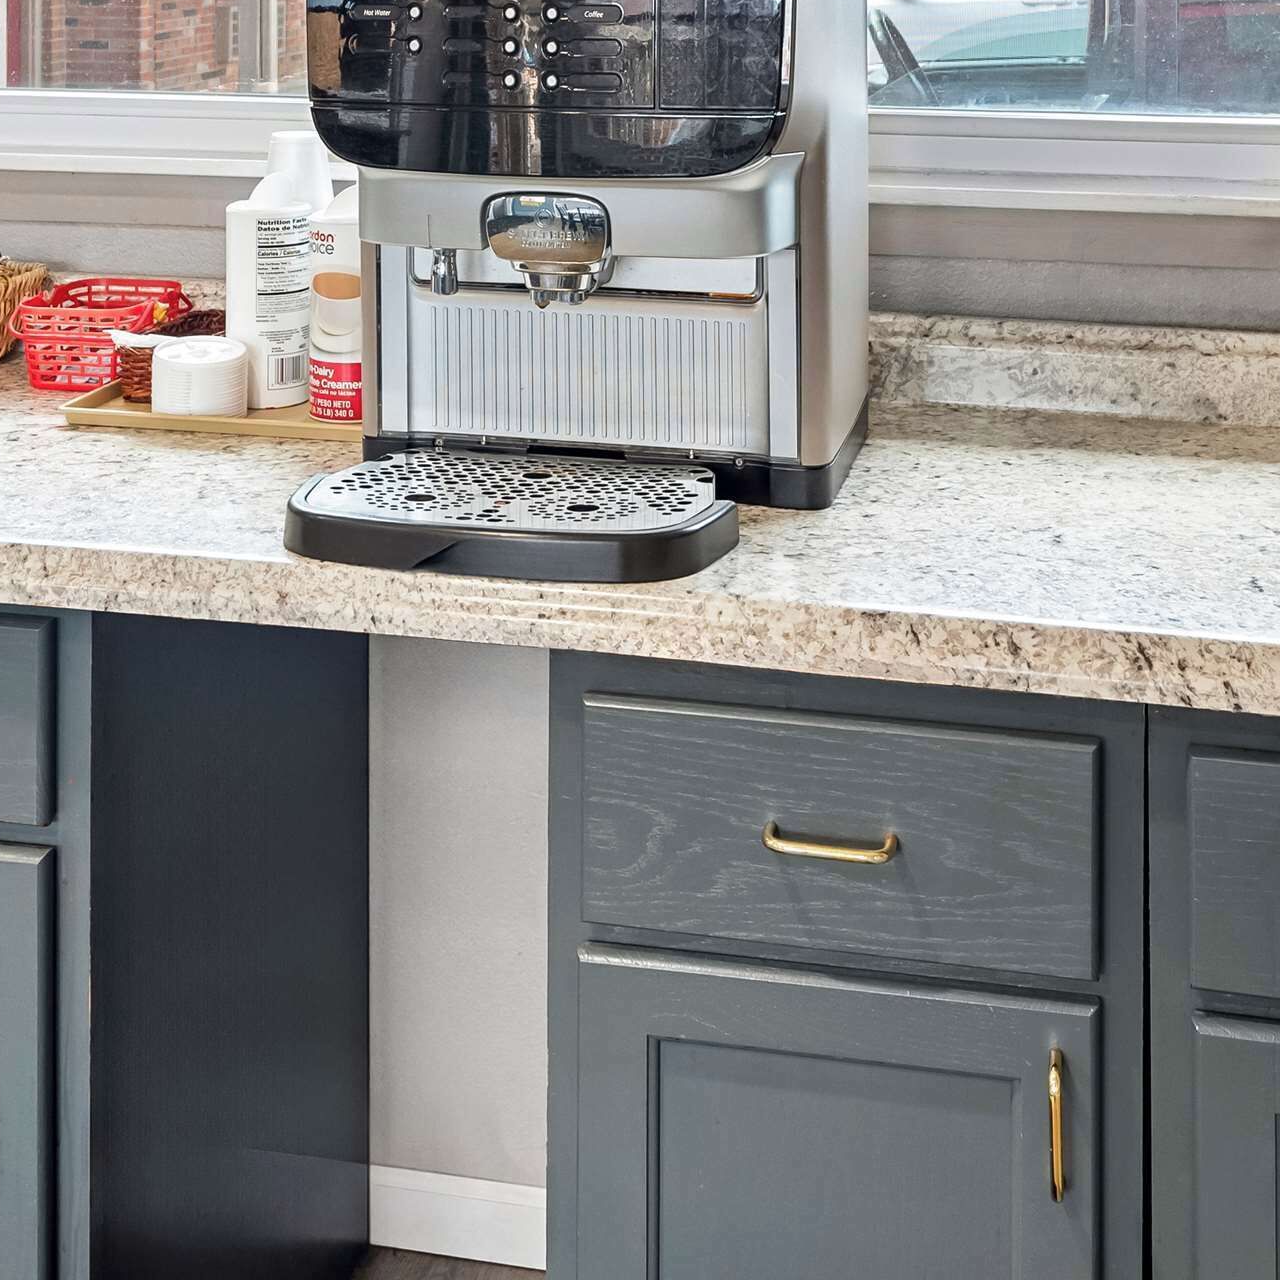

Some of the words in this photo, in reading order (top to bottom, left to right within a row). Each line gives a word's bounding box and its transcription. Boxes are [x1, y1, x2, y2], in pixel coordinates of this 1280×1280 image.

[363, 8, 374, 16] Hot
[375, 8, 392, 16] Water
[584, 10, 605, 18] Coffee
[321, 379, 362, 389] Creamer
[334, 409, 347, 417] 340
